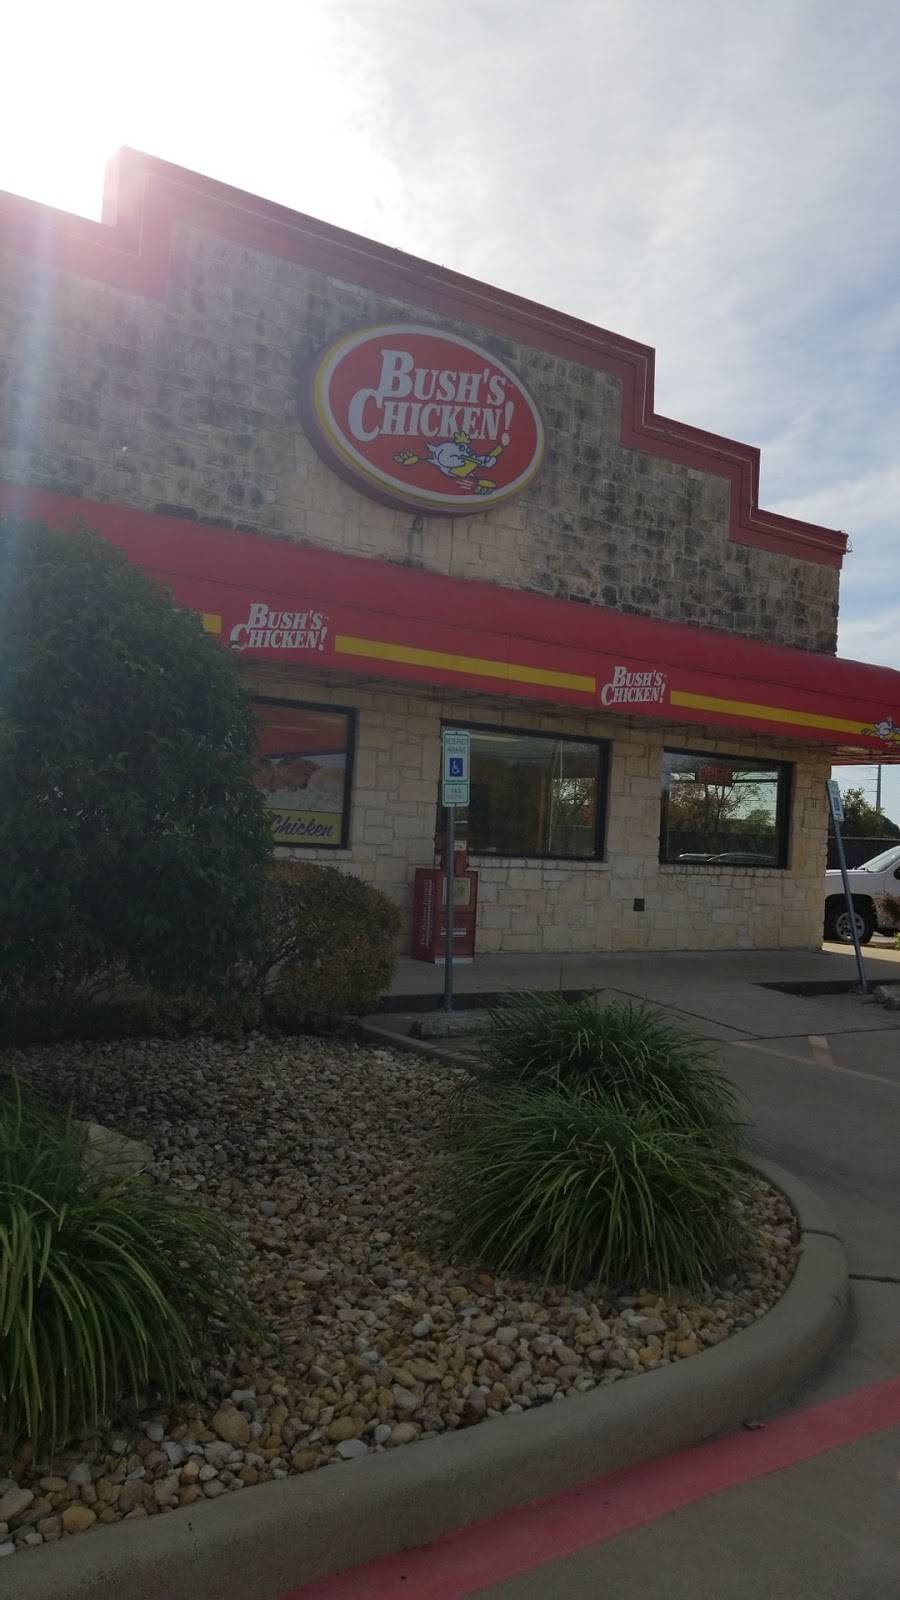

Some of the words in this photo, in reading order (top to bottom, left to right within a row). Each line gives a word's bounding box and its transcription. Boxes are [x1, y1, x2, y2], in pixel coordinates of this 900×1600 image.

[378, 350, 506, 406] BUSH'S
[348, 388, 515, 446] CHICKEN!
[247, 603, 322, 629] BUSH'S
[230, 624, 327, 652] CHICKEN!
[613, 666, 662, 686] BUSH'S
[601, 684, 665, 705] CHICKEN!
